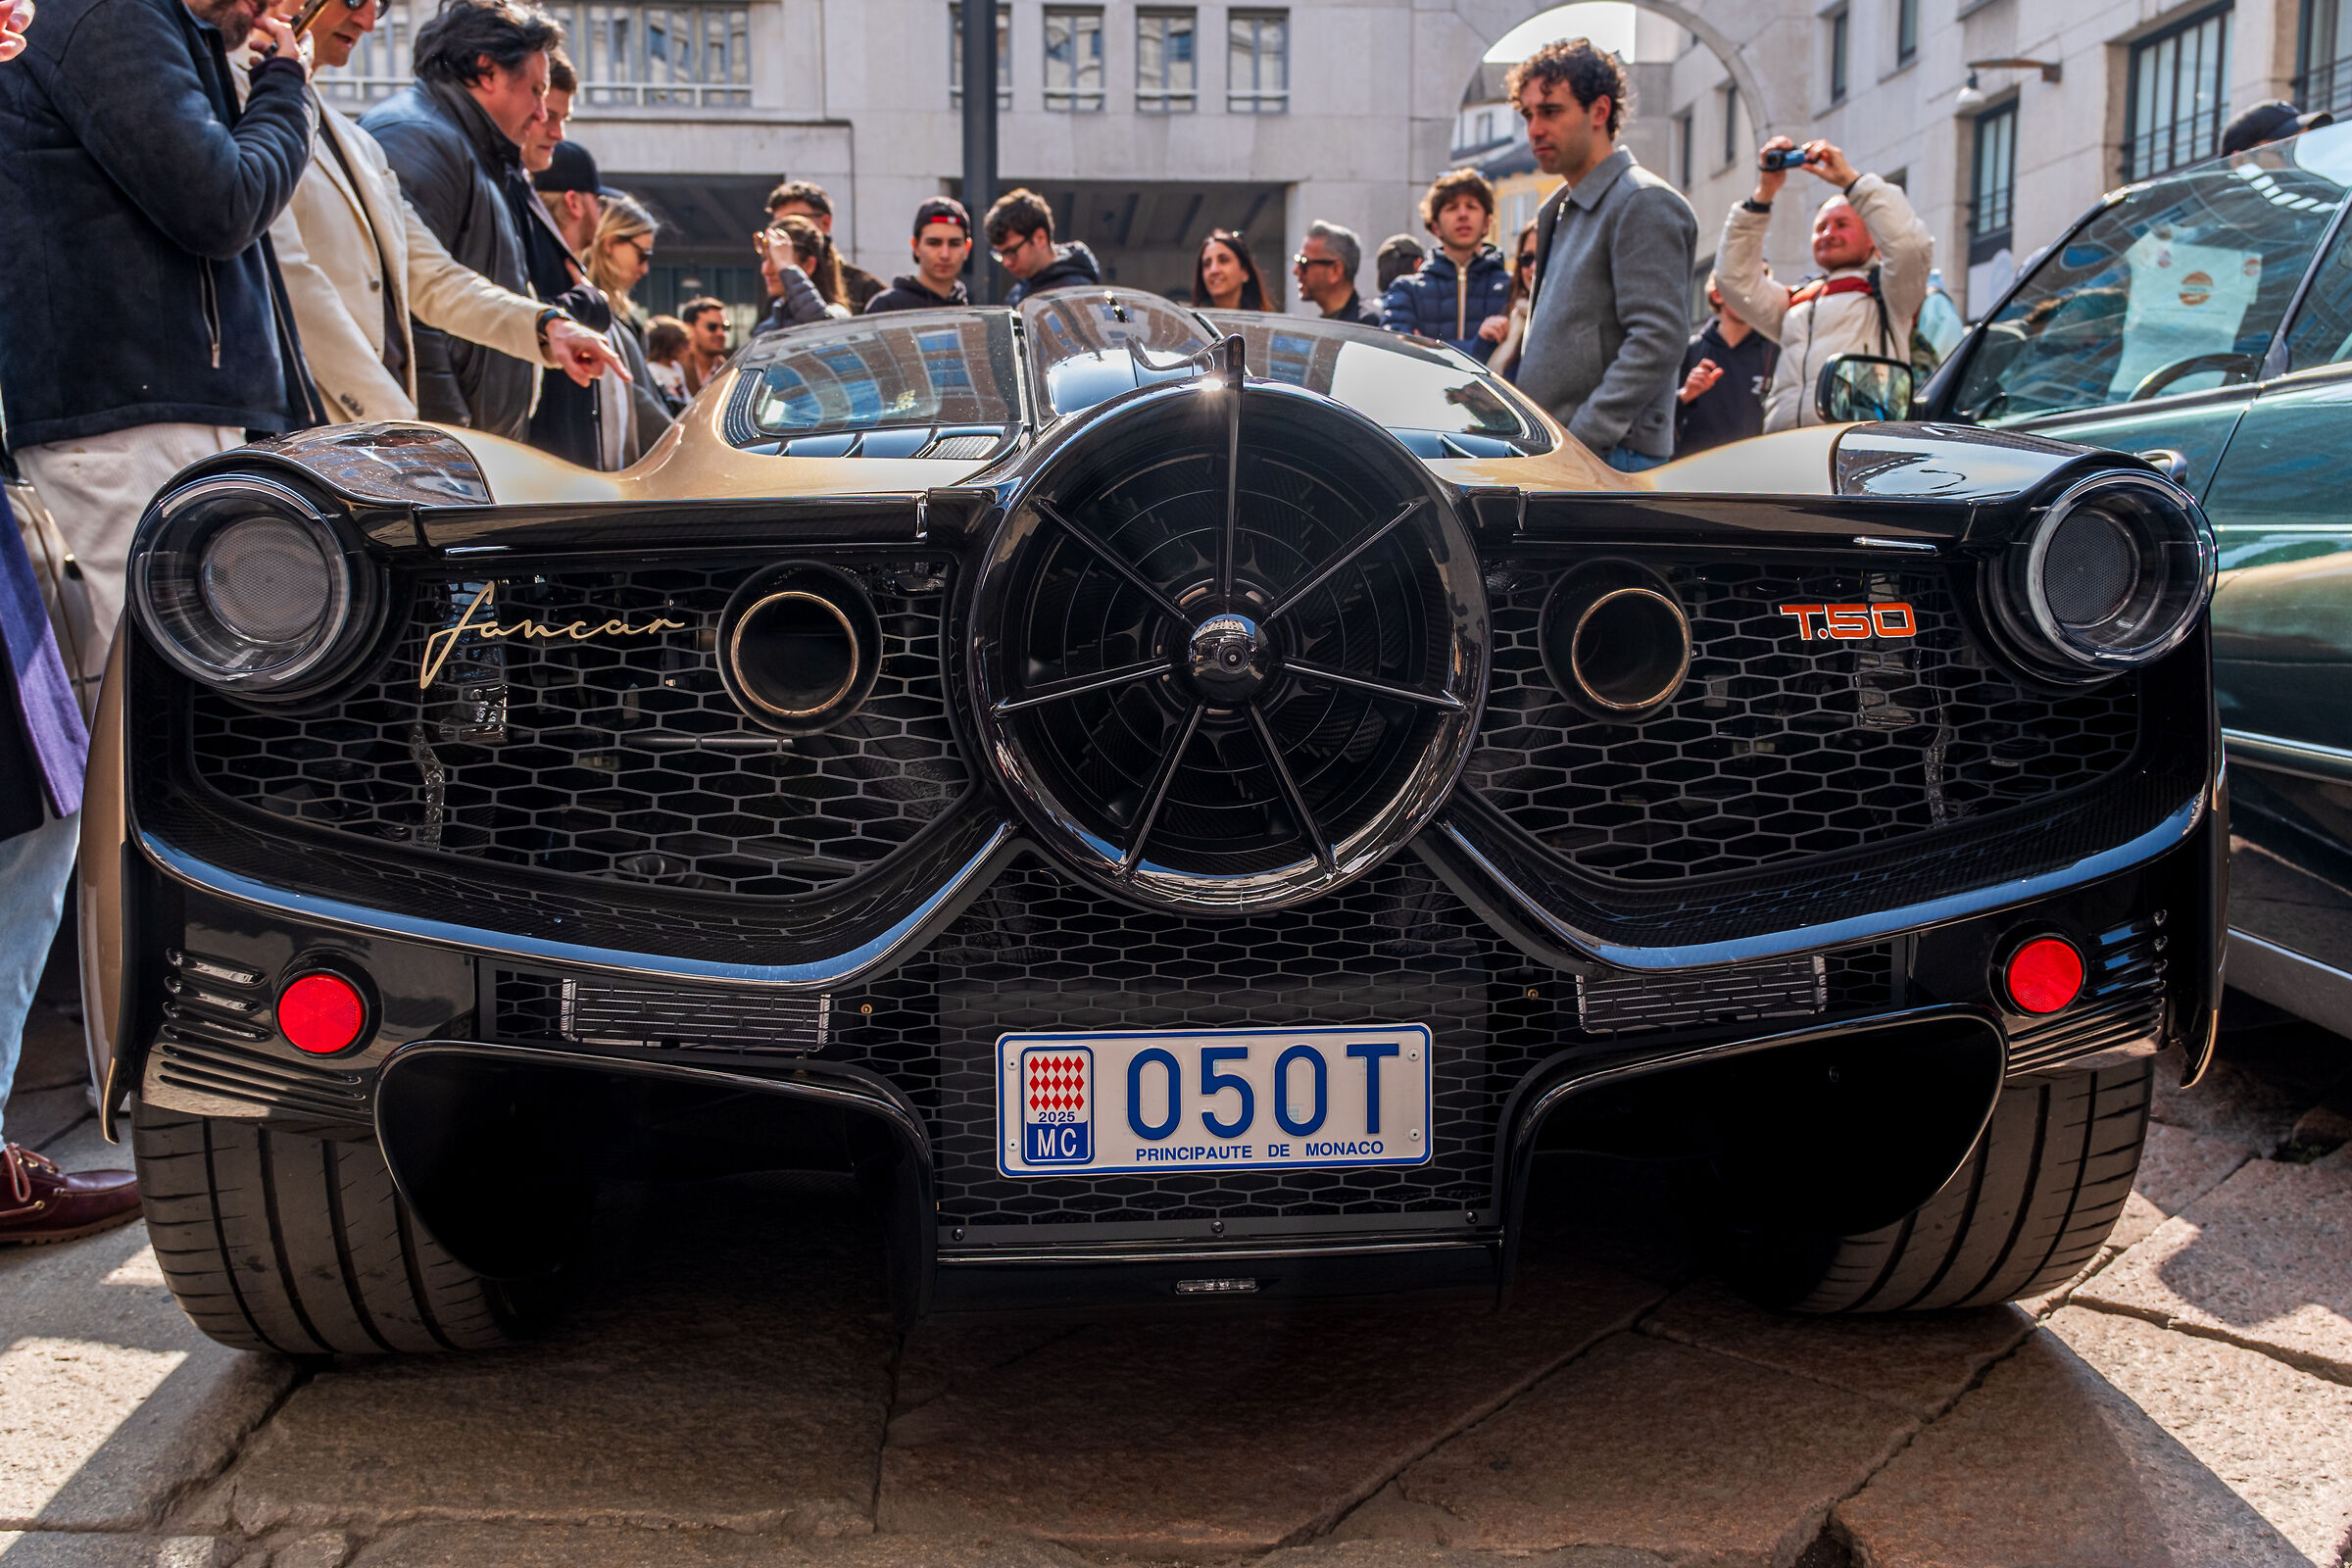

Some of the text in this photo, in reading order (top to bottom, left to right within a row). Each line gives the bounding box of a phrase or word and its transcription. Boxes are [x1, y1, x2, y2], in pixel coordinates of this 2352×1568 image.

[1779, 602, 1917, 641] T.50
[1126, 1042, 1400, 1142] 050T
[1038, 1110, 1076, 1123] 2025
[1037, 1127, 1077, 1157] MC
[1135, 1140, 1385, 1161] PRINCIPAUTE DE MONACO
